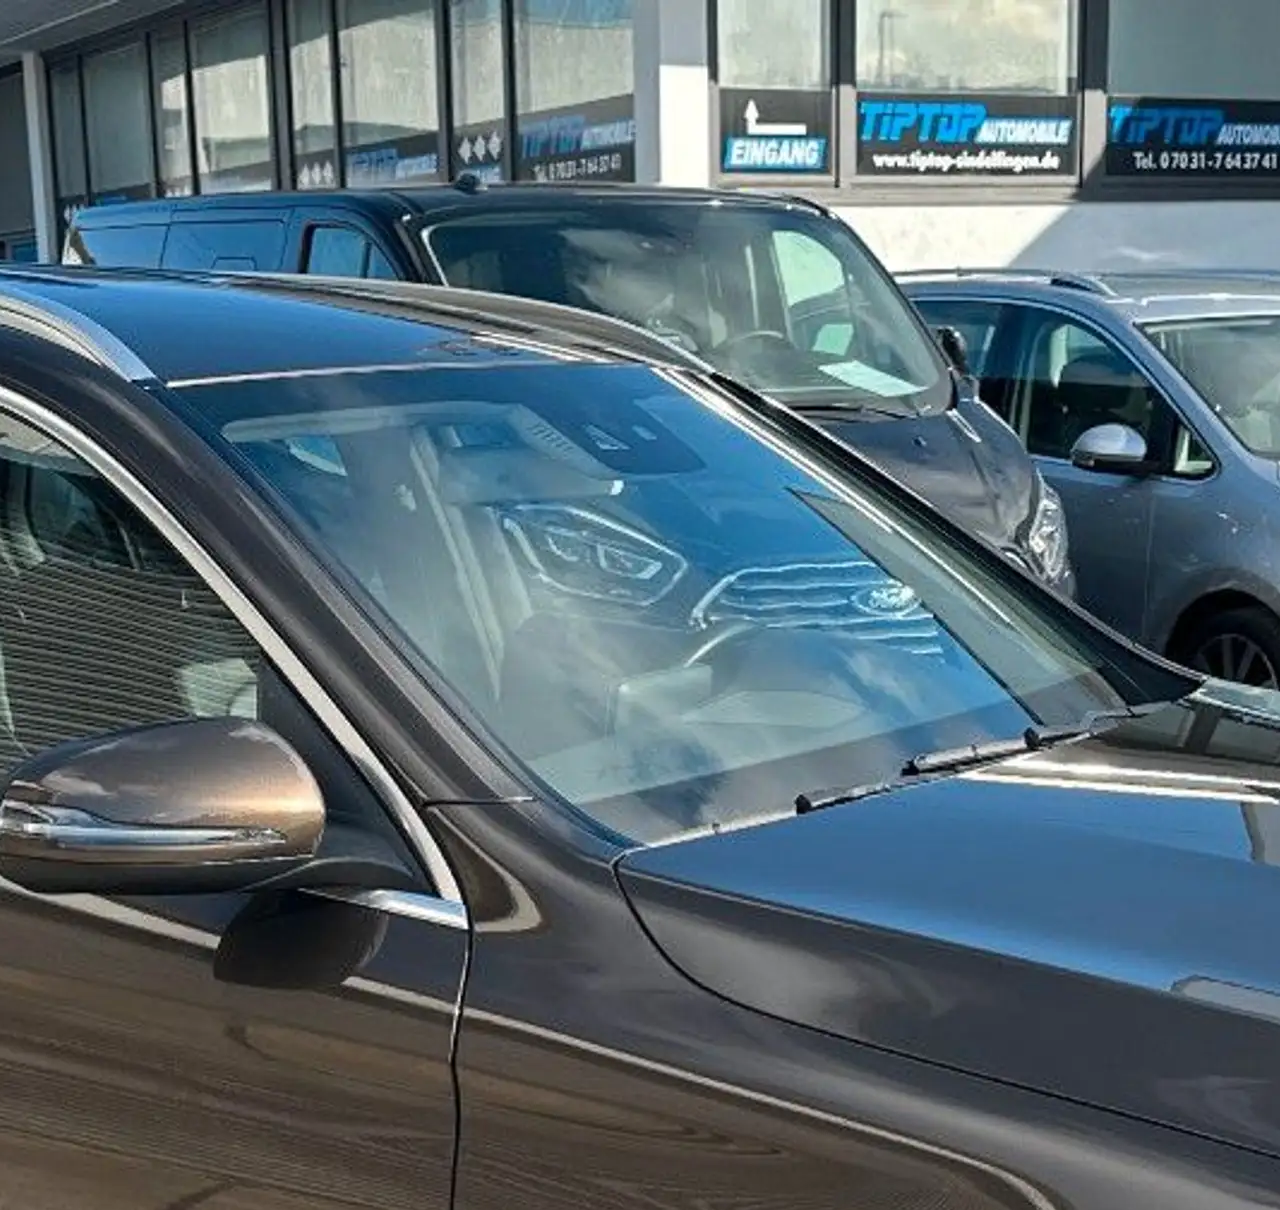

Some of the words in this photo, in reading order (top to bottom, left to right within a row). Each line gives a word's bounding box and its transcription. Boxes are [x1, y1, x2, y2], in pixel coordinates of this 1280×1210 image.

[974, 119, 1072, 144] AUTOMOBILE
[730, 139, 820, 166] EINGANG
[1132, 150, 1158, 170] Tel.
